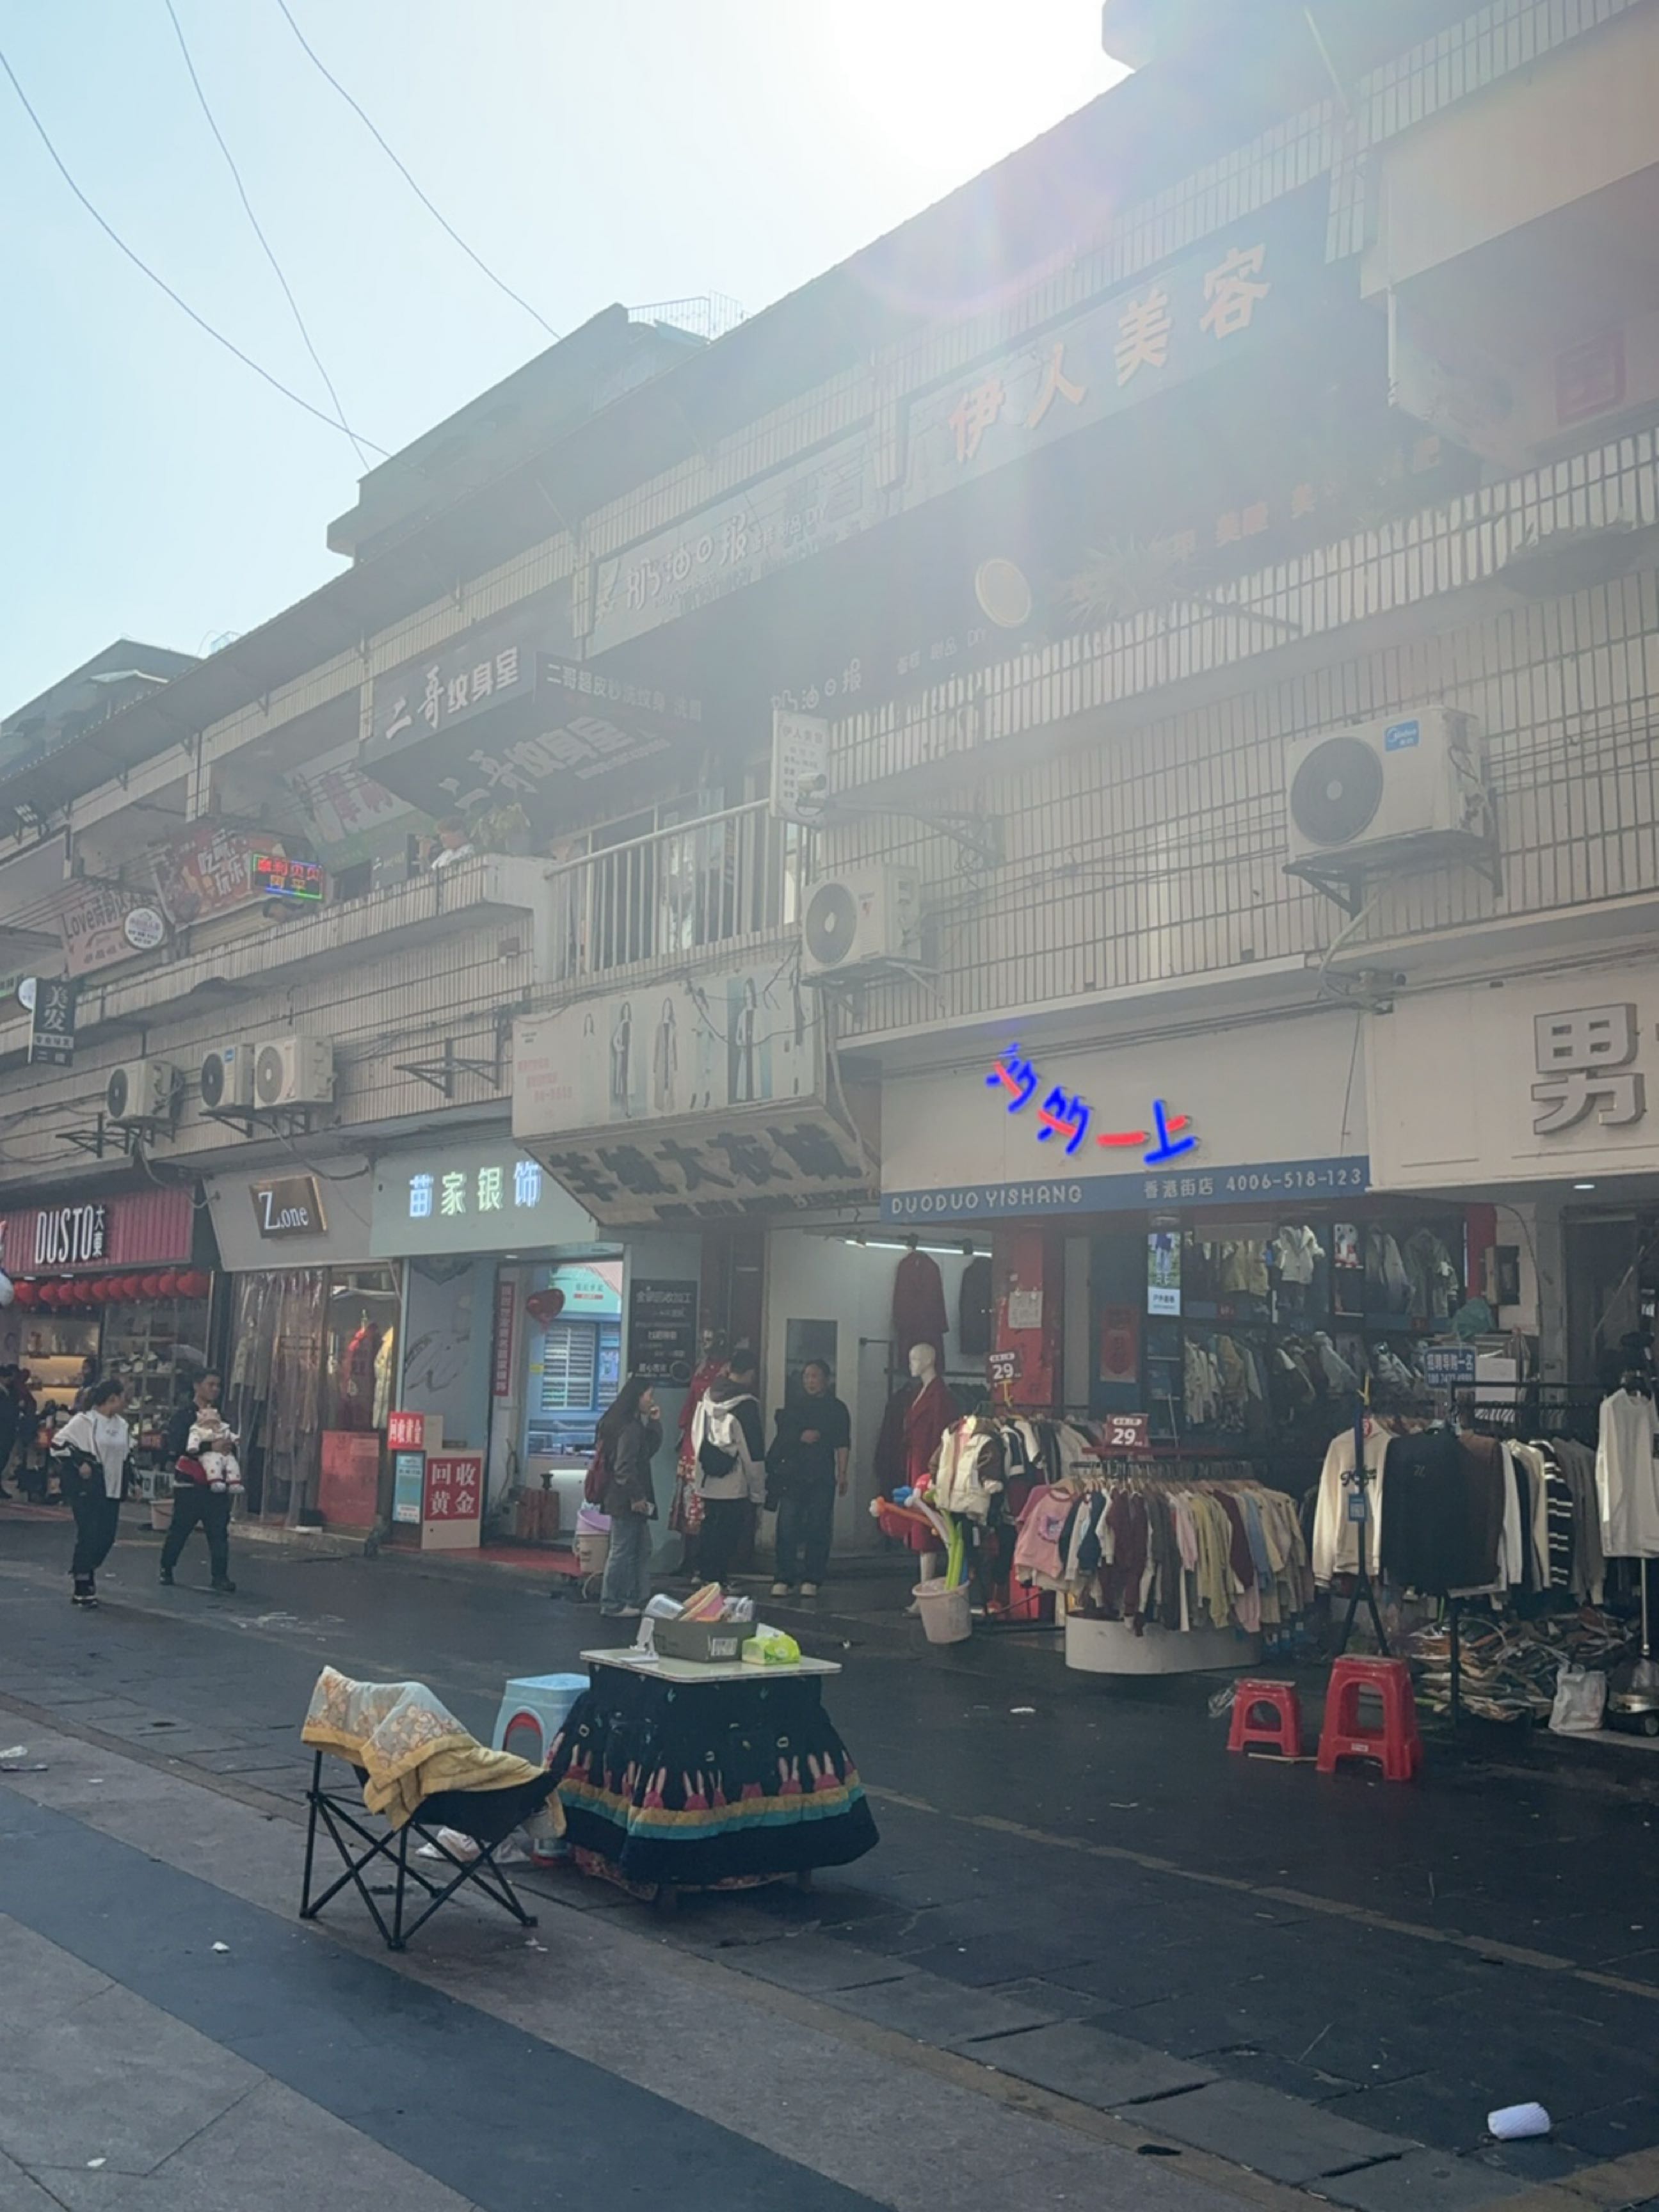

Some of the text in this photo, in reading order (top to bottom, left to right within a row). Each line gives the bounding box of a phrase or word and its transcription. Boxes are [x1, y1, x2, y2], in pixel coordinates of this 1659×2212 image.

[949, 243, 1270, 464] 伊人美容
[626, 511, 748, 610] 奶油日报
[43, 985, 68, 1032] 美发
[409, 1160, 542, 1219] 苗家银饰
[1144, 1167, 1362, 1199] 香港街店 4006-518-123
[892, 1190, 979, 1215] DUODUO
[986, 1184, 1083, 1208] YISHANG
[35, 1204, 93, 1264] DUSTO
[993, 1363, 1014, 1380] 29
[390, 1417, 422, 1443] 回收黄金
[1111, 1428, 1136, 1445] 29
[431, 1463, 476, 1486] 回收
[430, 1490, 476, 1516] 黄金
